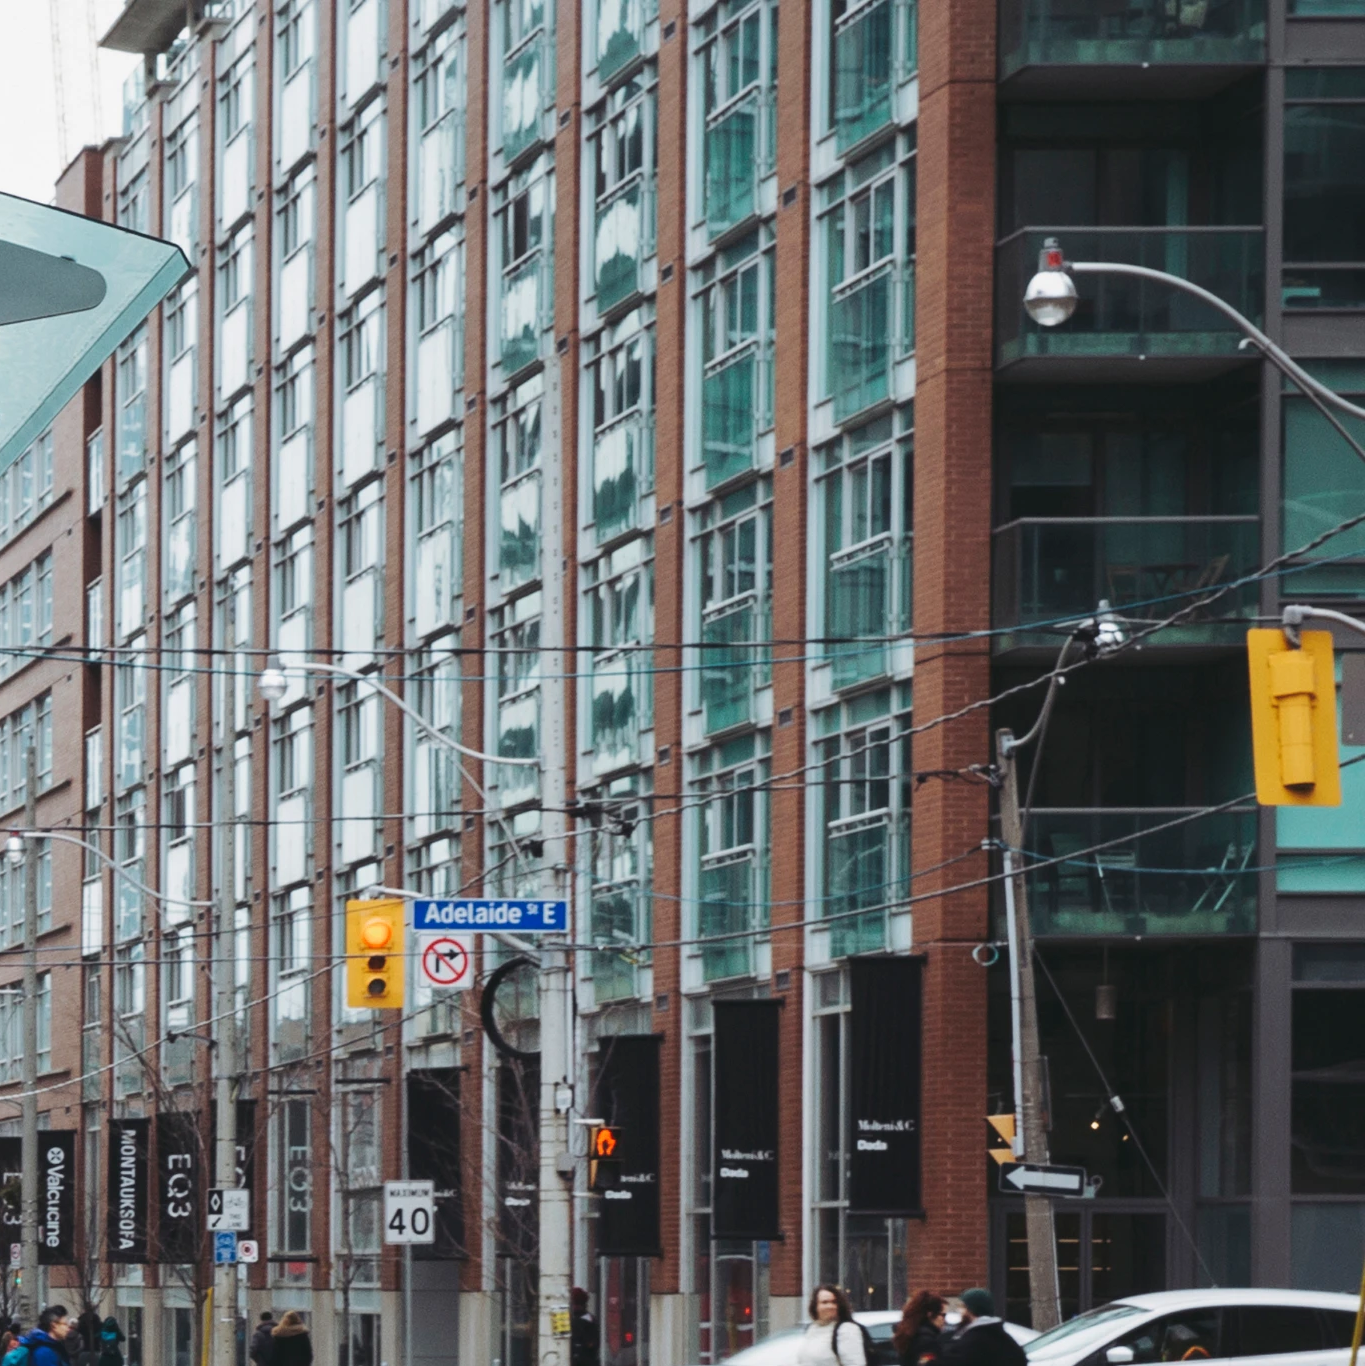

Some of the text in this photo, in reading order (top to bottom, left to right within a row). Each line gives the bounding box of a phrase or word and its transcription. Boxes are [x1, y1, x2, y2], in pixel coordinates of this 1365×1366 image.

[424, 903, 556, 924] Adelaide St E
[46, 1165, 65, 1248] Valcucine
[119, 1129, 136, 1250] MONTAUKSOFA
[167, 1154, 192, 1218] EQ3
[388, 1207, 429, 1235] 40
